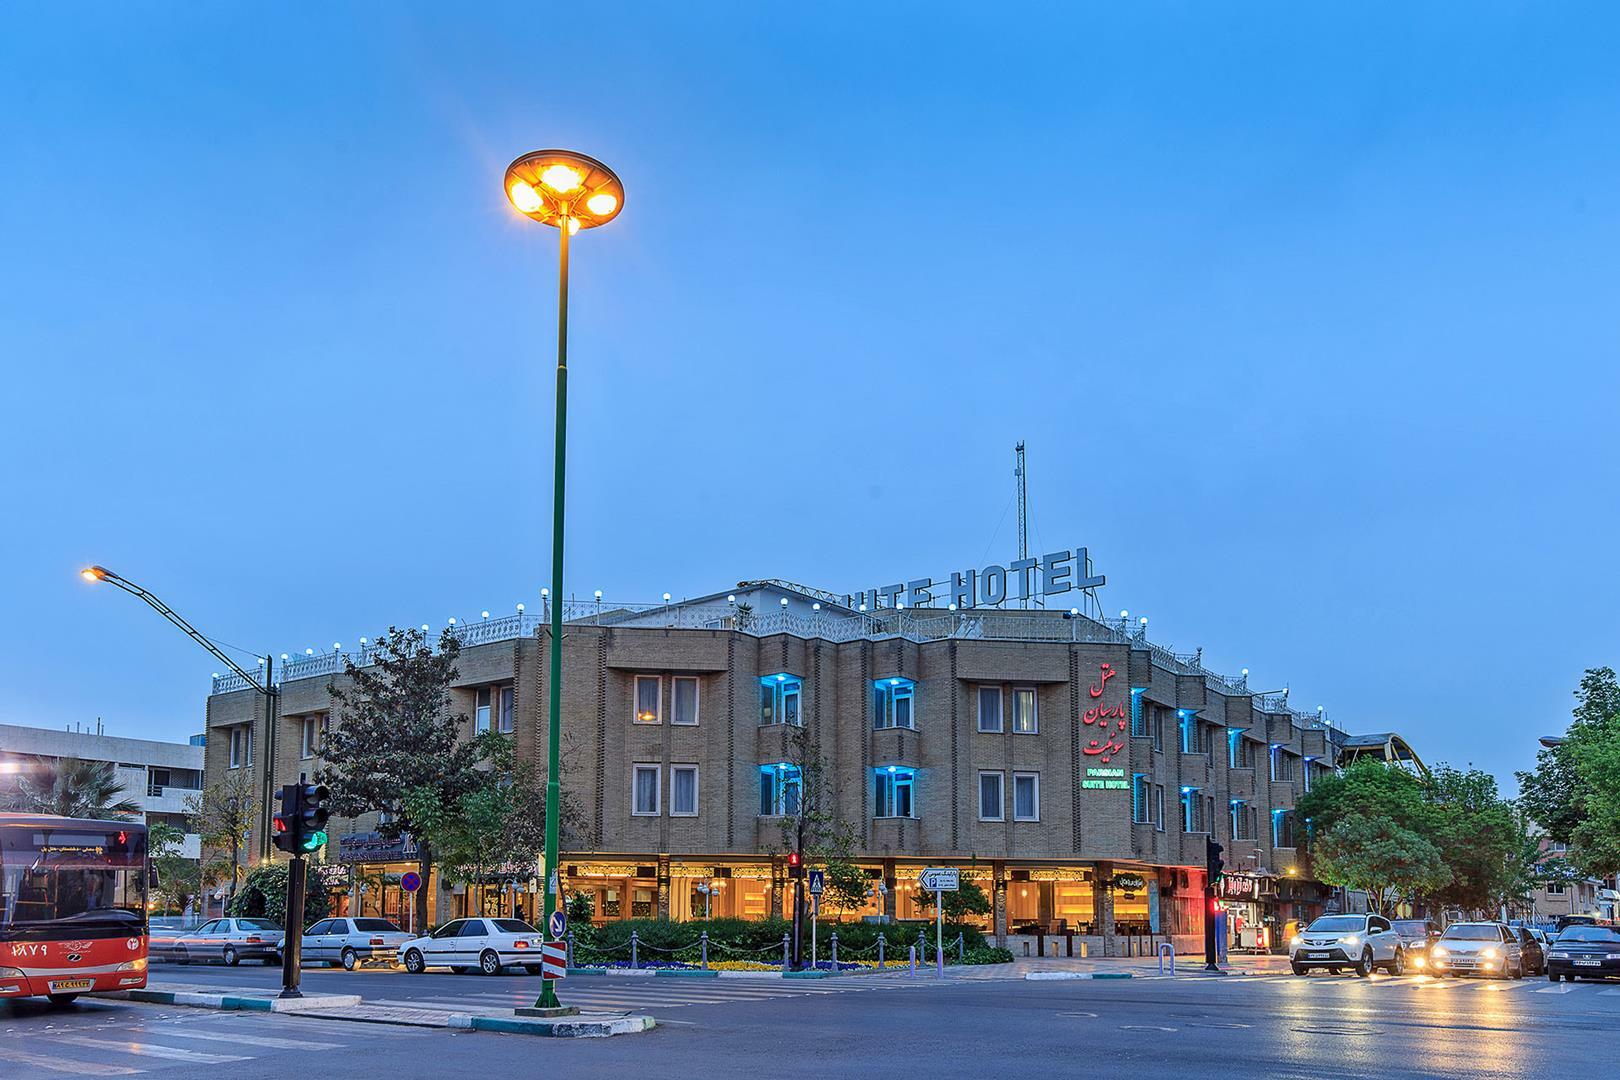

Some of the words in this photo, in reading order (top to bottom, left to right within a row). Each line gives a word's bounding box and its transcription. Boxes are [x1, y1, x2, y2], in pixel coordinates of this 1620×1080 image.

[840, 578, 932, 610] UITE
[950, 547, 1106, 609] HOTEL
[1089, 662, 1117, 697] هتل
[1083, 701, 1126, 730] پارسیان
[1081, 780, 1105, 789] SUITE
[1105, 780, 1130, 789] HOTEL
